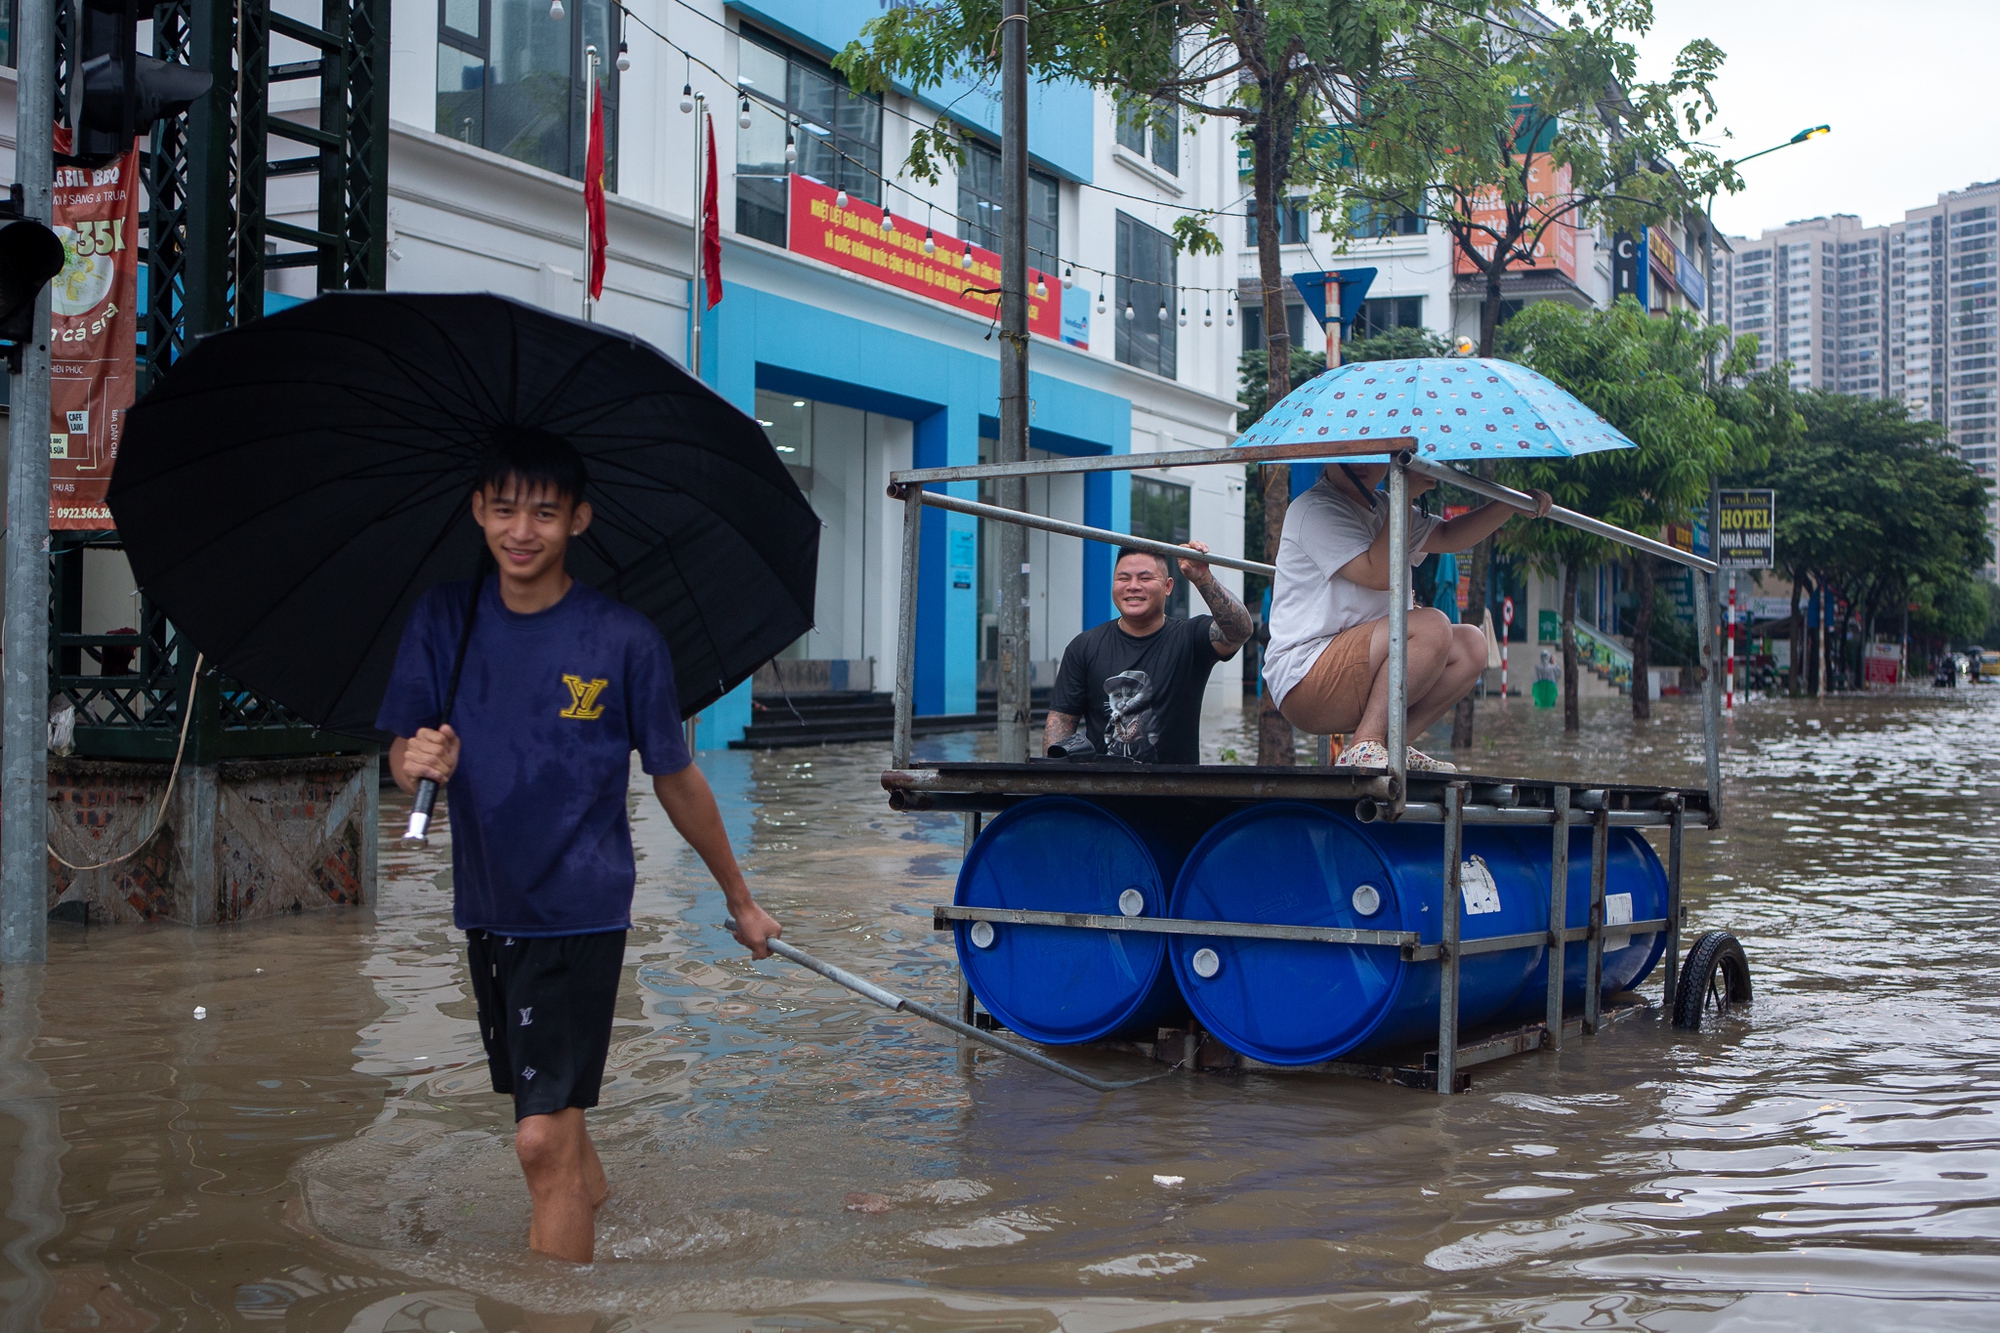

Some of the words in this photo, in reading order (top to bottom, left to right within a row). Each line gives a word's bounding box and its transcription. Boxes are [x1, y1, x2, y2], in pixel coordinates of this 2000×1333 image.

[65, 170, 88, 187] BIL
[92, 166, 120, 186] BBQ
[76, 216, 126, 256] 35K
[62, 321, 87, 342] cá
[68, 413, 82, 422] CAFE
[111, 409, 119, 422] BIA
[57, 507, 113, 519] 0922.366.36
[1721, 509, 1771, 530] HOTEL
[1720, 530, 1743, 549] NHÀ
